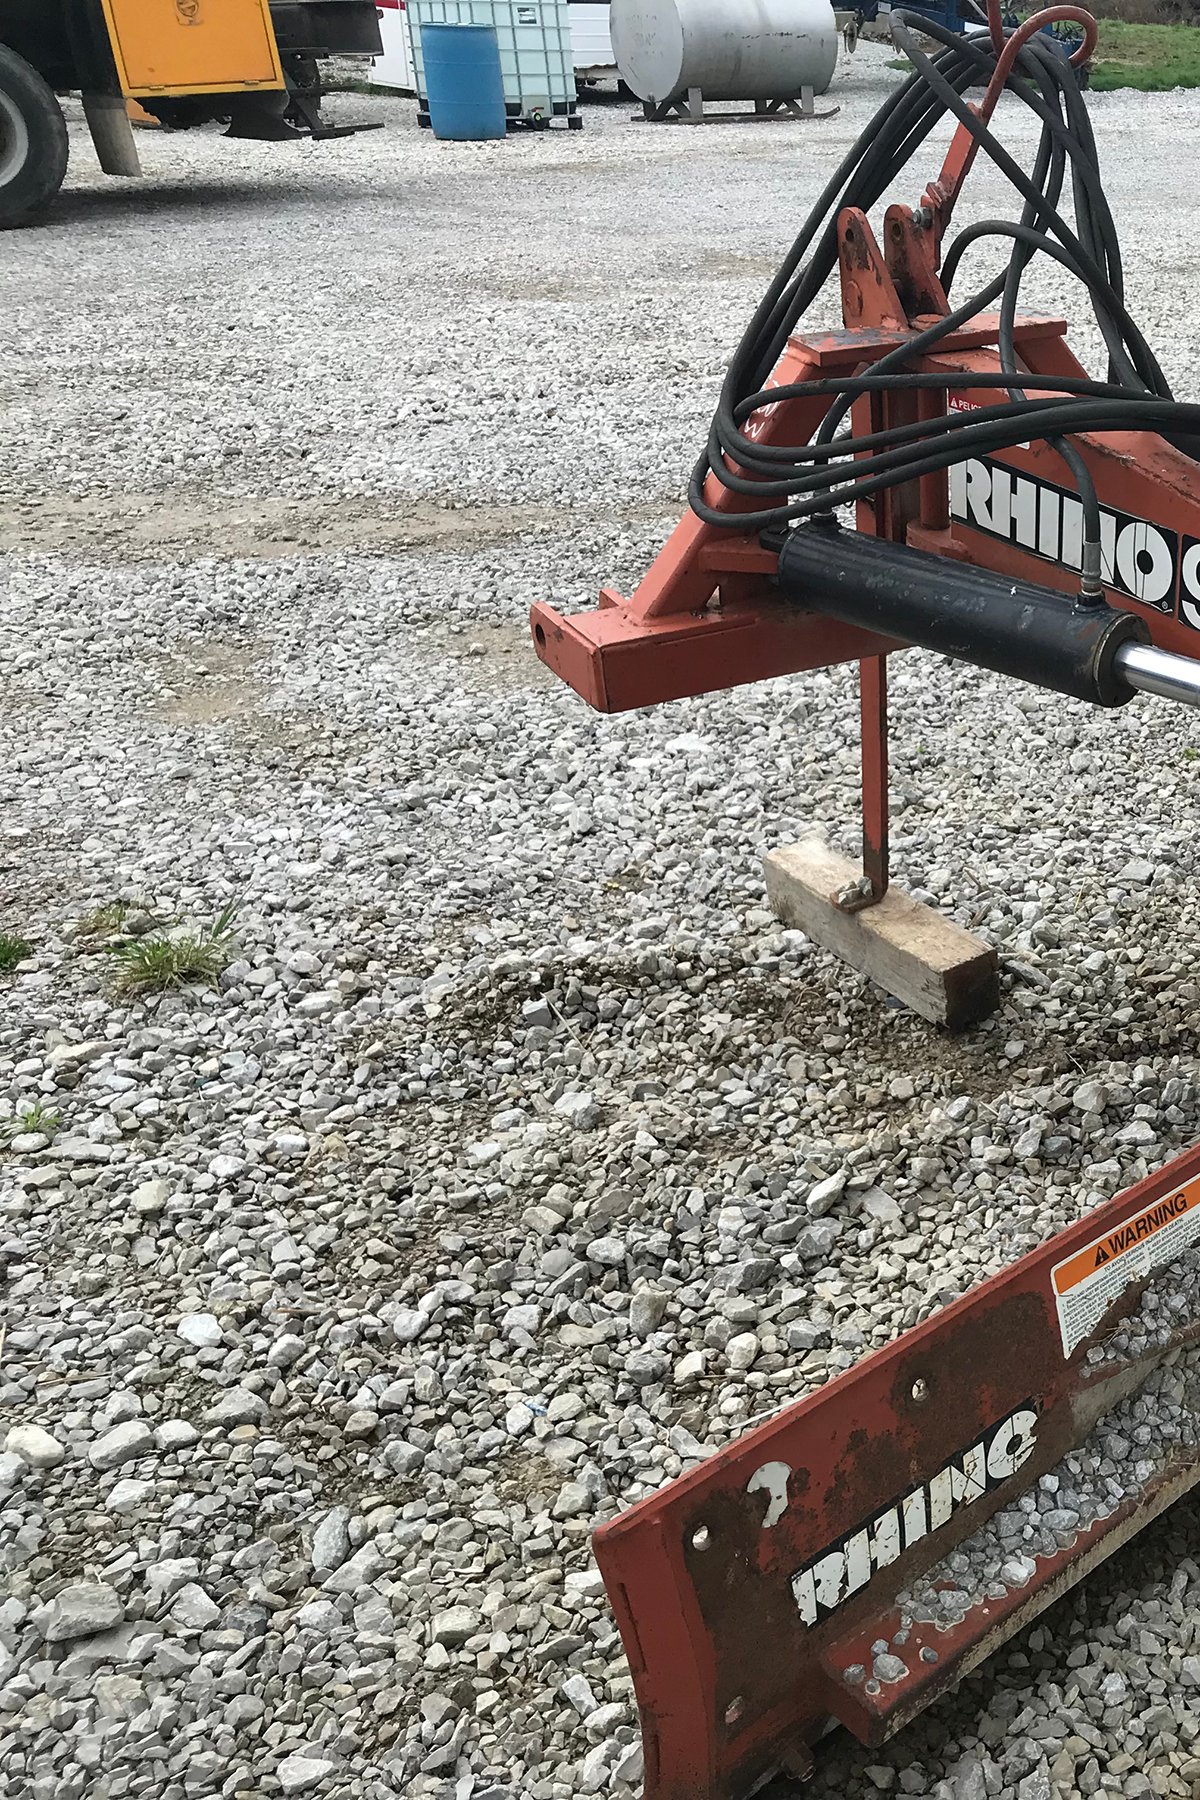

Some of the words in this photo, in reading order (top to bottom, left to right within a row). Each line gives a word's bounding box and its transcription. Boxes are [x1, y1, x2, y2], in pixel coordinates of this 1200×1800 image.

[951, 457, 1173, 601] RHINO
[1108, 1193, 1188, 1255] WARNING
[791, 1410, 1037, 1627] RHINO
